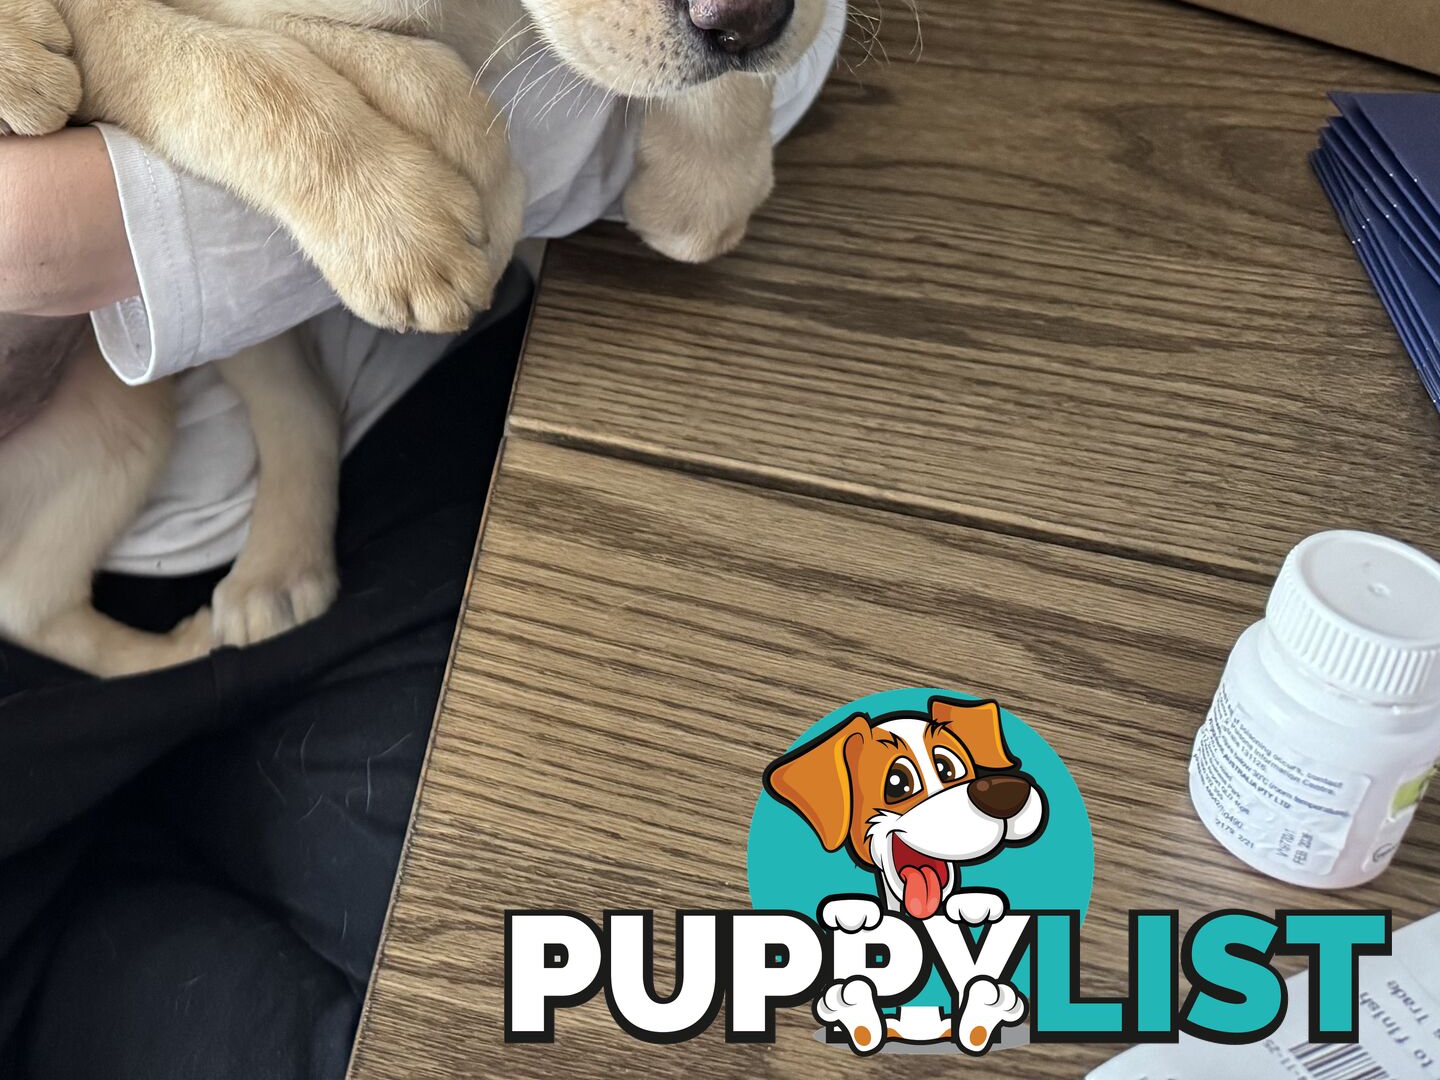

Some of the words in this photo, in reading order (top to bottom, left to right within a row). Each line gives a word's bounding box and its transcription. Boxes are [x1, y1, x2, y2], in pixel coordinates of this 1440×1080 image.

[1223, 754, 1257, 789] AUSTRALIA
[1257, 786, 1274, 799] PTY
[1274, 796, 1292, 809] LTD
[1387, 980, 1429, 1024] Trade
[1413, 1048, 1434, 1069] to
